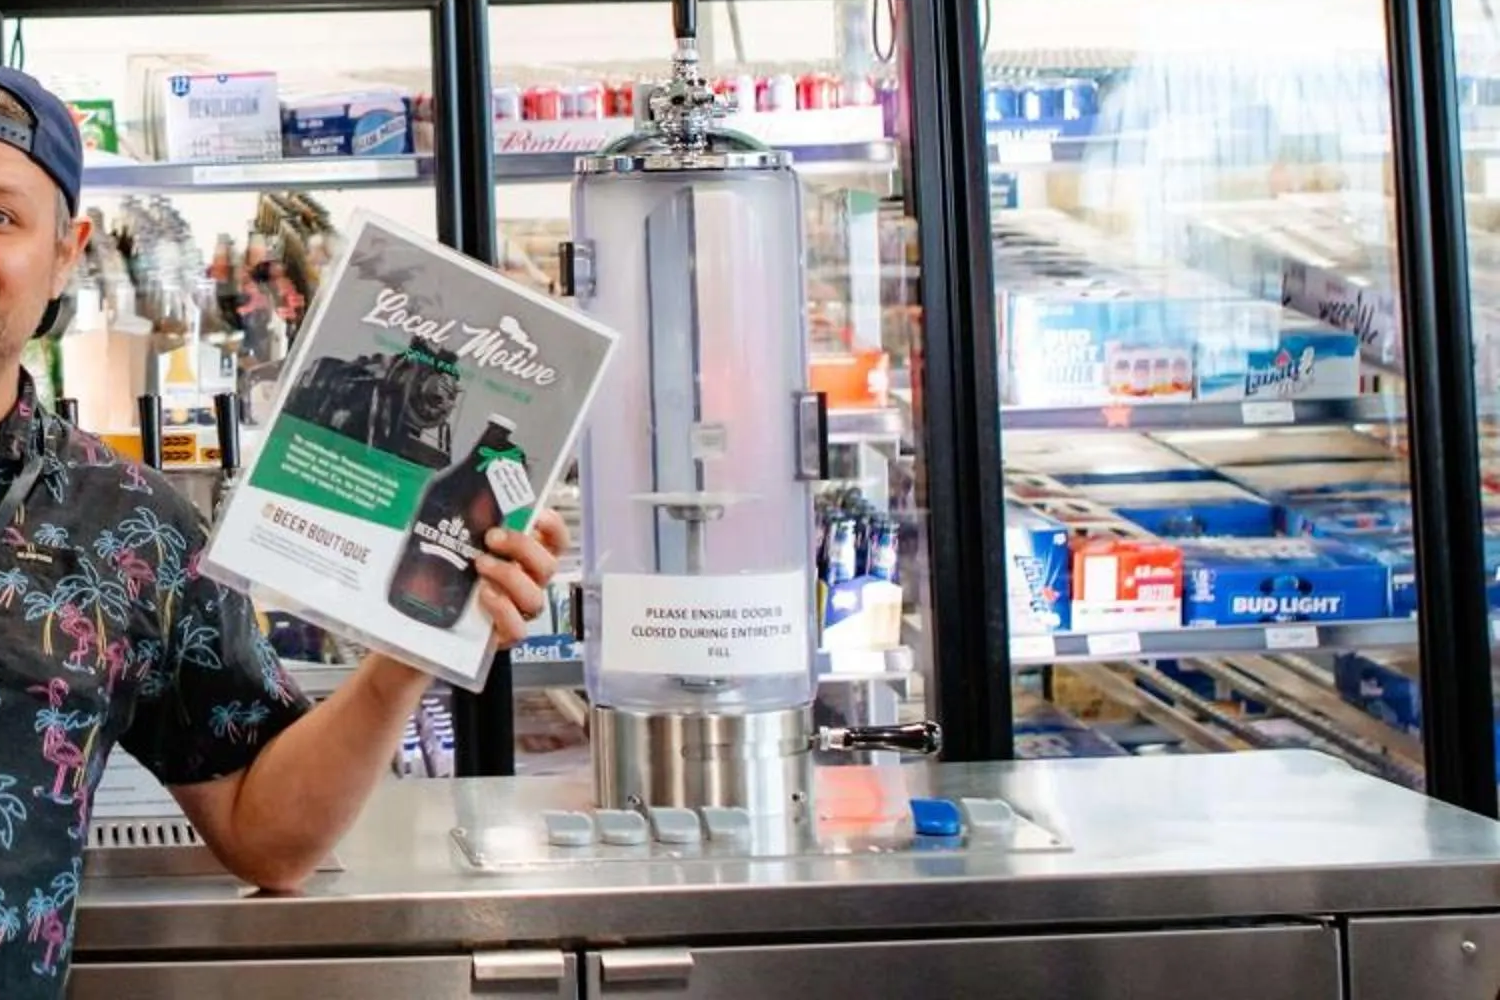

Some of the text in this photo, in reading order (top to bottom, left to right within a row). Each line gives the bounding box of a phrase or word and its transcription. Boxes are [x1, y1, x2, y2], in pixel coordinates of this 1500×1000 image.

[361, 288, 457, 344] Local
[457, 321, 557, 386] Motive
[272, 506, 308, 537] BEER
[307, 523, 371, 564] BOUTIQUE
[645, 607, 687, 620] PLEASE
[691, 608, 737, 620] ENSURE
[1232, 596, 1341, 614] BUD LIGHT
[631, 625, 677, 638] CLOSED
[679, 627, 728, 639] DURING
